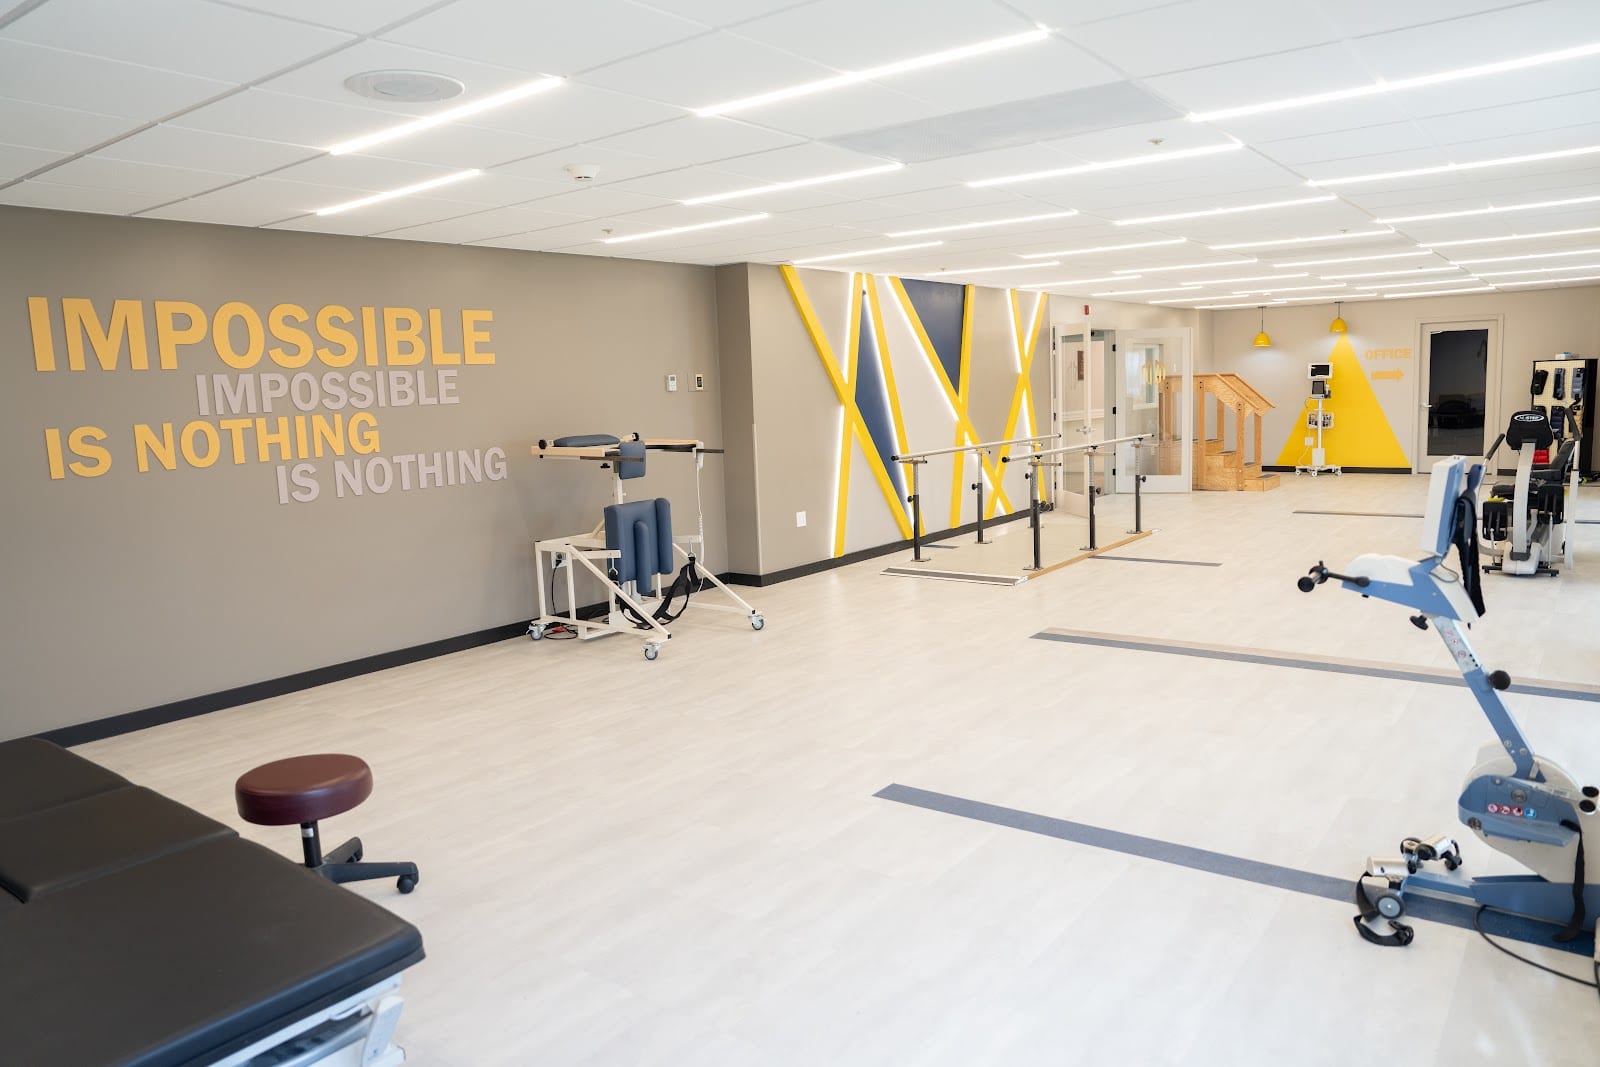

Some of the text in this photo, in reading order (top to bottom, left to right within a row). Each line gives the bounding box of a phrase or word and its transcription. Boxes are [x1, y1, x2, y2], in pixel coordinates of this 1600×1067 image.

[27, 296, 496, 372] IMPOSSIBLE
[1364, 348, 1412, 360] OFFICE
[195, 369, 460, 416] IMPOSSIBLE
[44, 412, 381, 480] IS NOTHING
[276, 446, 508, 505] IS NOTHING
